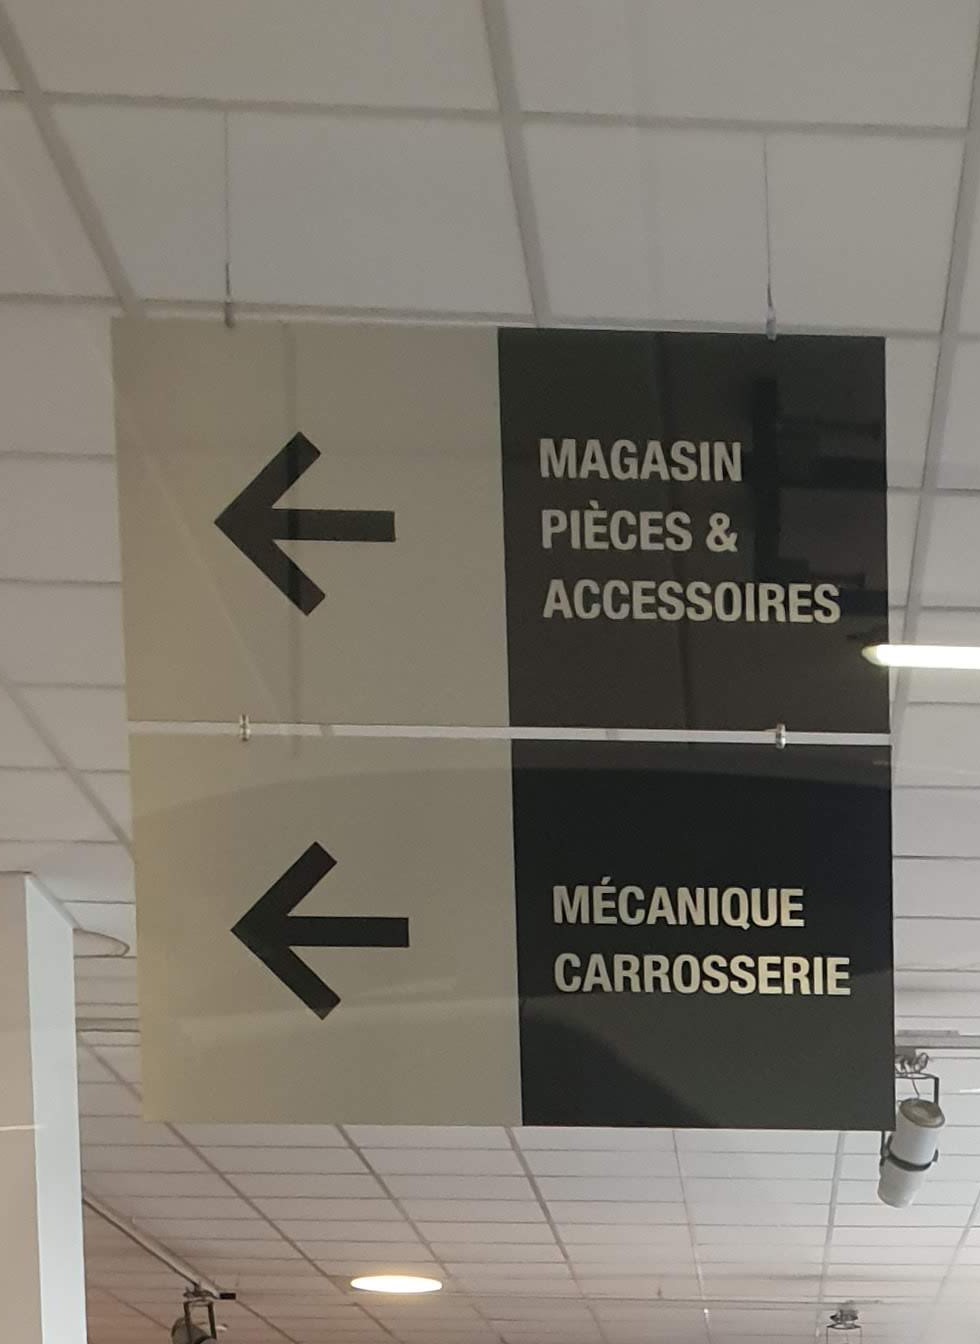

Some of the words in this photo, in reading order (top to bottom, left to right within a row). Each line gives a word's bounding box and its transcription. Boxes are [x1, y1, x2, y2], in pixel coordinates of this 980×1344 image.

[539, 438, 743, 481] MAGASIN
[541, 500, 692, 551] PIÈCES
[706, 512, 738, 552] &
[543, 578, 841, 623] ACCESSOIRES
[553, 876, 805, 930] MÉCANIQUE
[554, 953, 851, 996] CARROSSERIE
